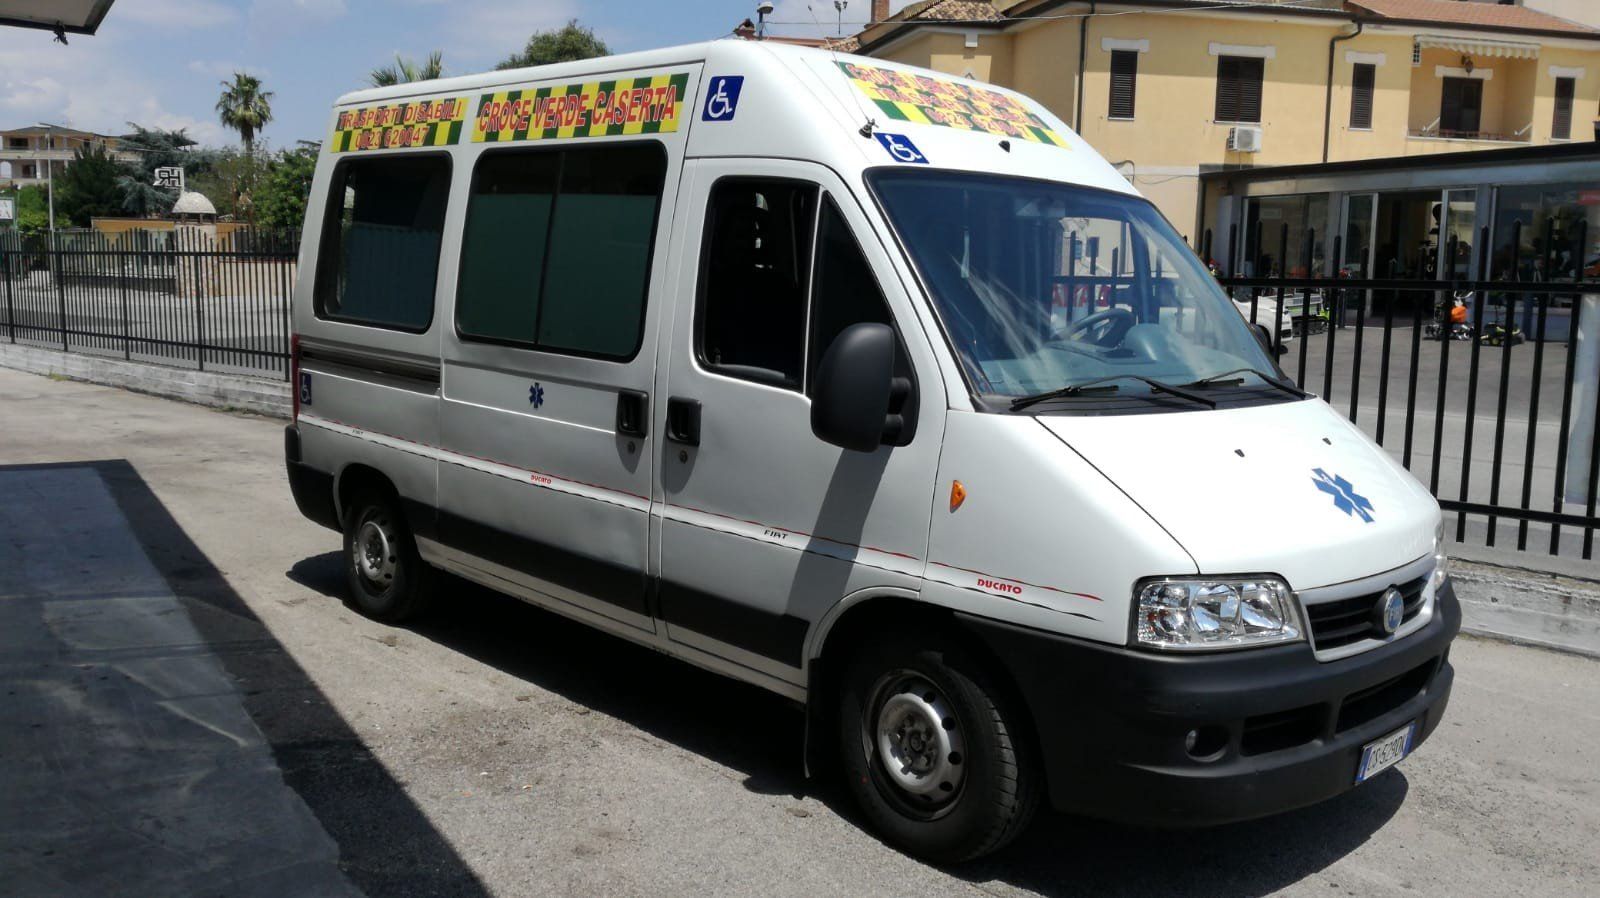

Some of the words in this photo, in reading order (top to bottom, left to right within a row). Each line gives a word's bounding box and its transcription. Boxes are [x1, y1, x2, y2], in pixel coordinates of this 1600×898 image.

[340, 106, 404, 130] TRASPORTI
[404, 100, 463, 122] DISABILI
[479, 97, 532, 133] CROCE
[534, 93, 590, 129] VERDE
[591, 84, 678, 126] CASERTA
[531, 474, 552, 484] DUCATO
[763, 529, 789, 540] FIAT
[977, 578, 1023, 595] DUCATO
